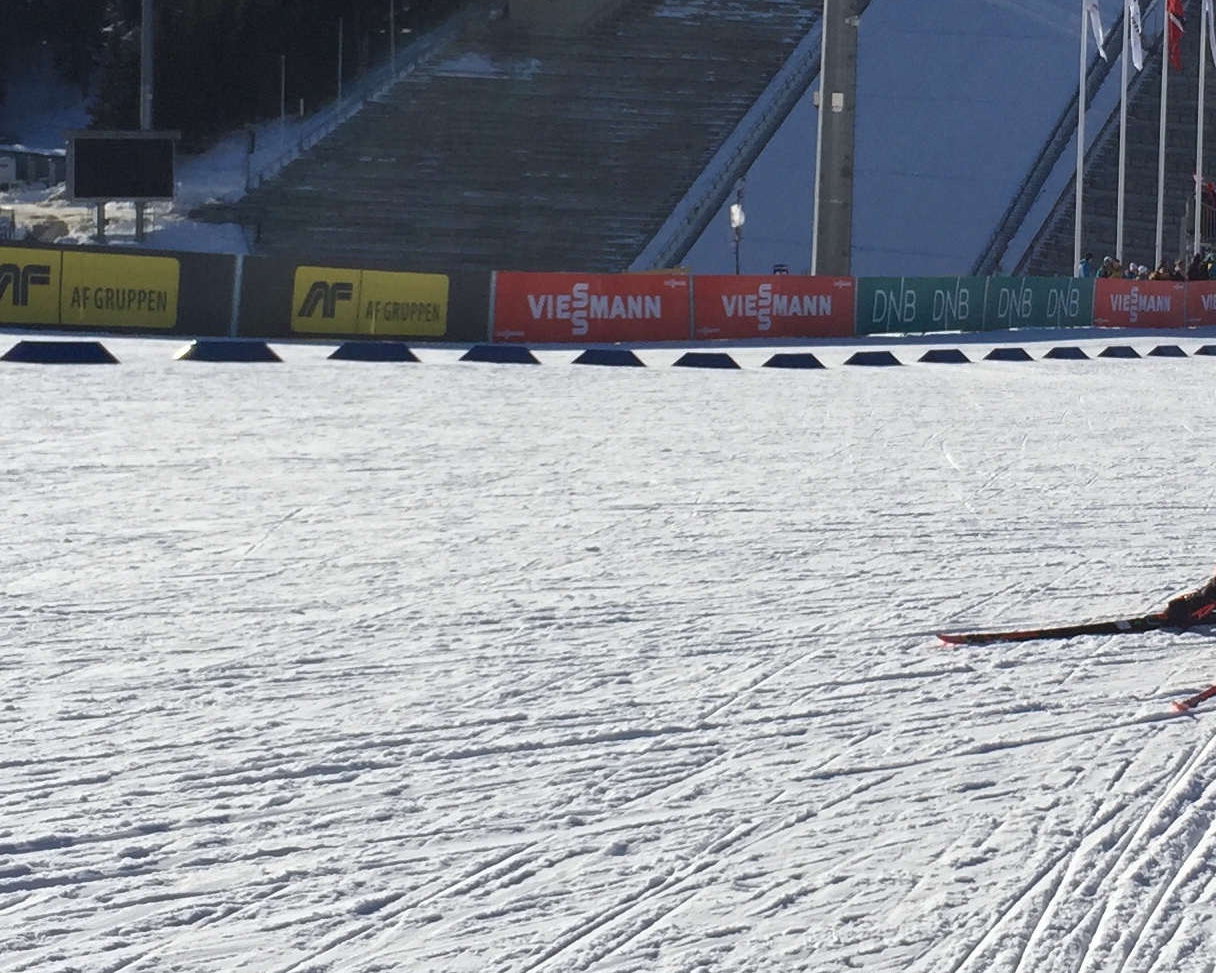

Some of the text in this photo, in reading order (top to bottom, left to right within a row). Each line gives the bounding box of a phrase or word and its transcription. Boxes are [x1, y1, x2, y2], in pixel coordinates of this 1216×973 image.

[0, 263, 51, 306] AF
[70, 286, 167, 312] AF GRUPPEN
[298, 281, 353, 319] AF
[872, 283, 917, 327] DNB
[932, 282, 970, 326] DNB
[998, 281, 1033, 324] DNB
[1046, 281, 1081, 324] DNB
[1110, 286, 1172, 323] VIESSMANN
[365, 300, 440, 322] AF GRUPPEN
[527, 282, 662, 335] VIESSMANN
[721, 283, 832, 331] VIESSMANN
